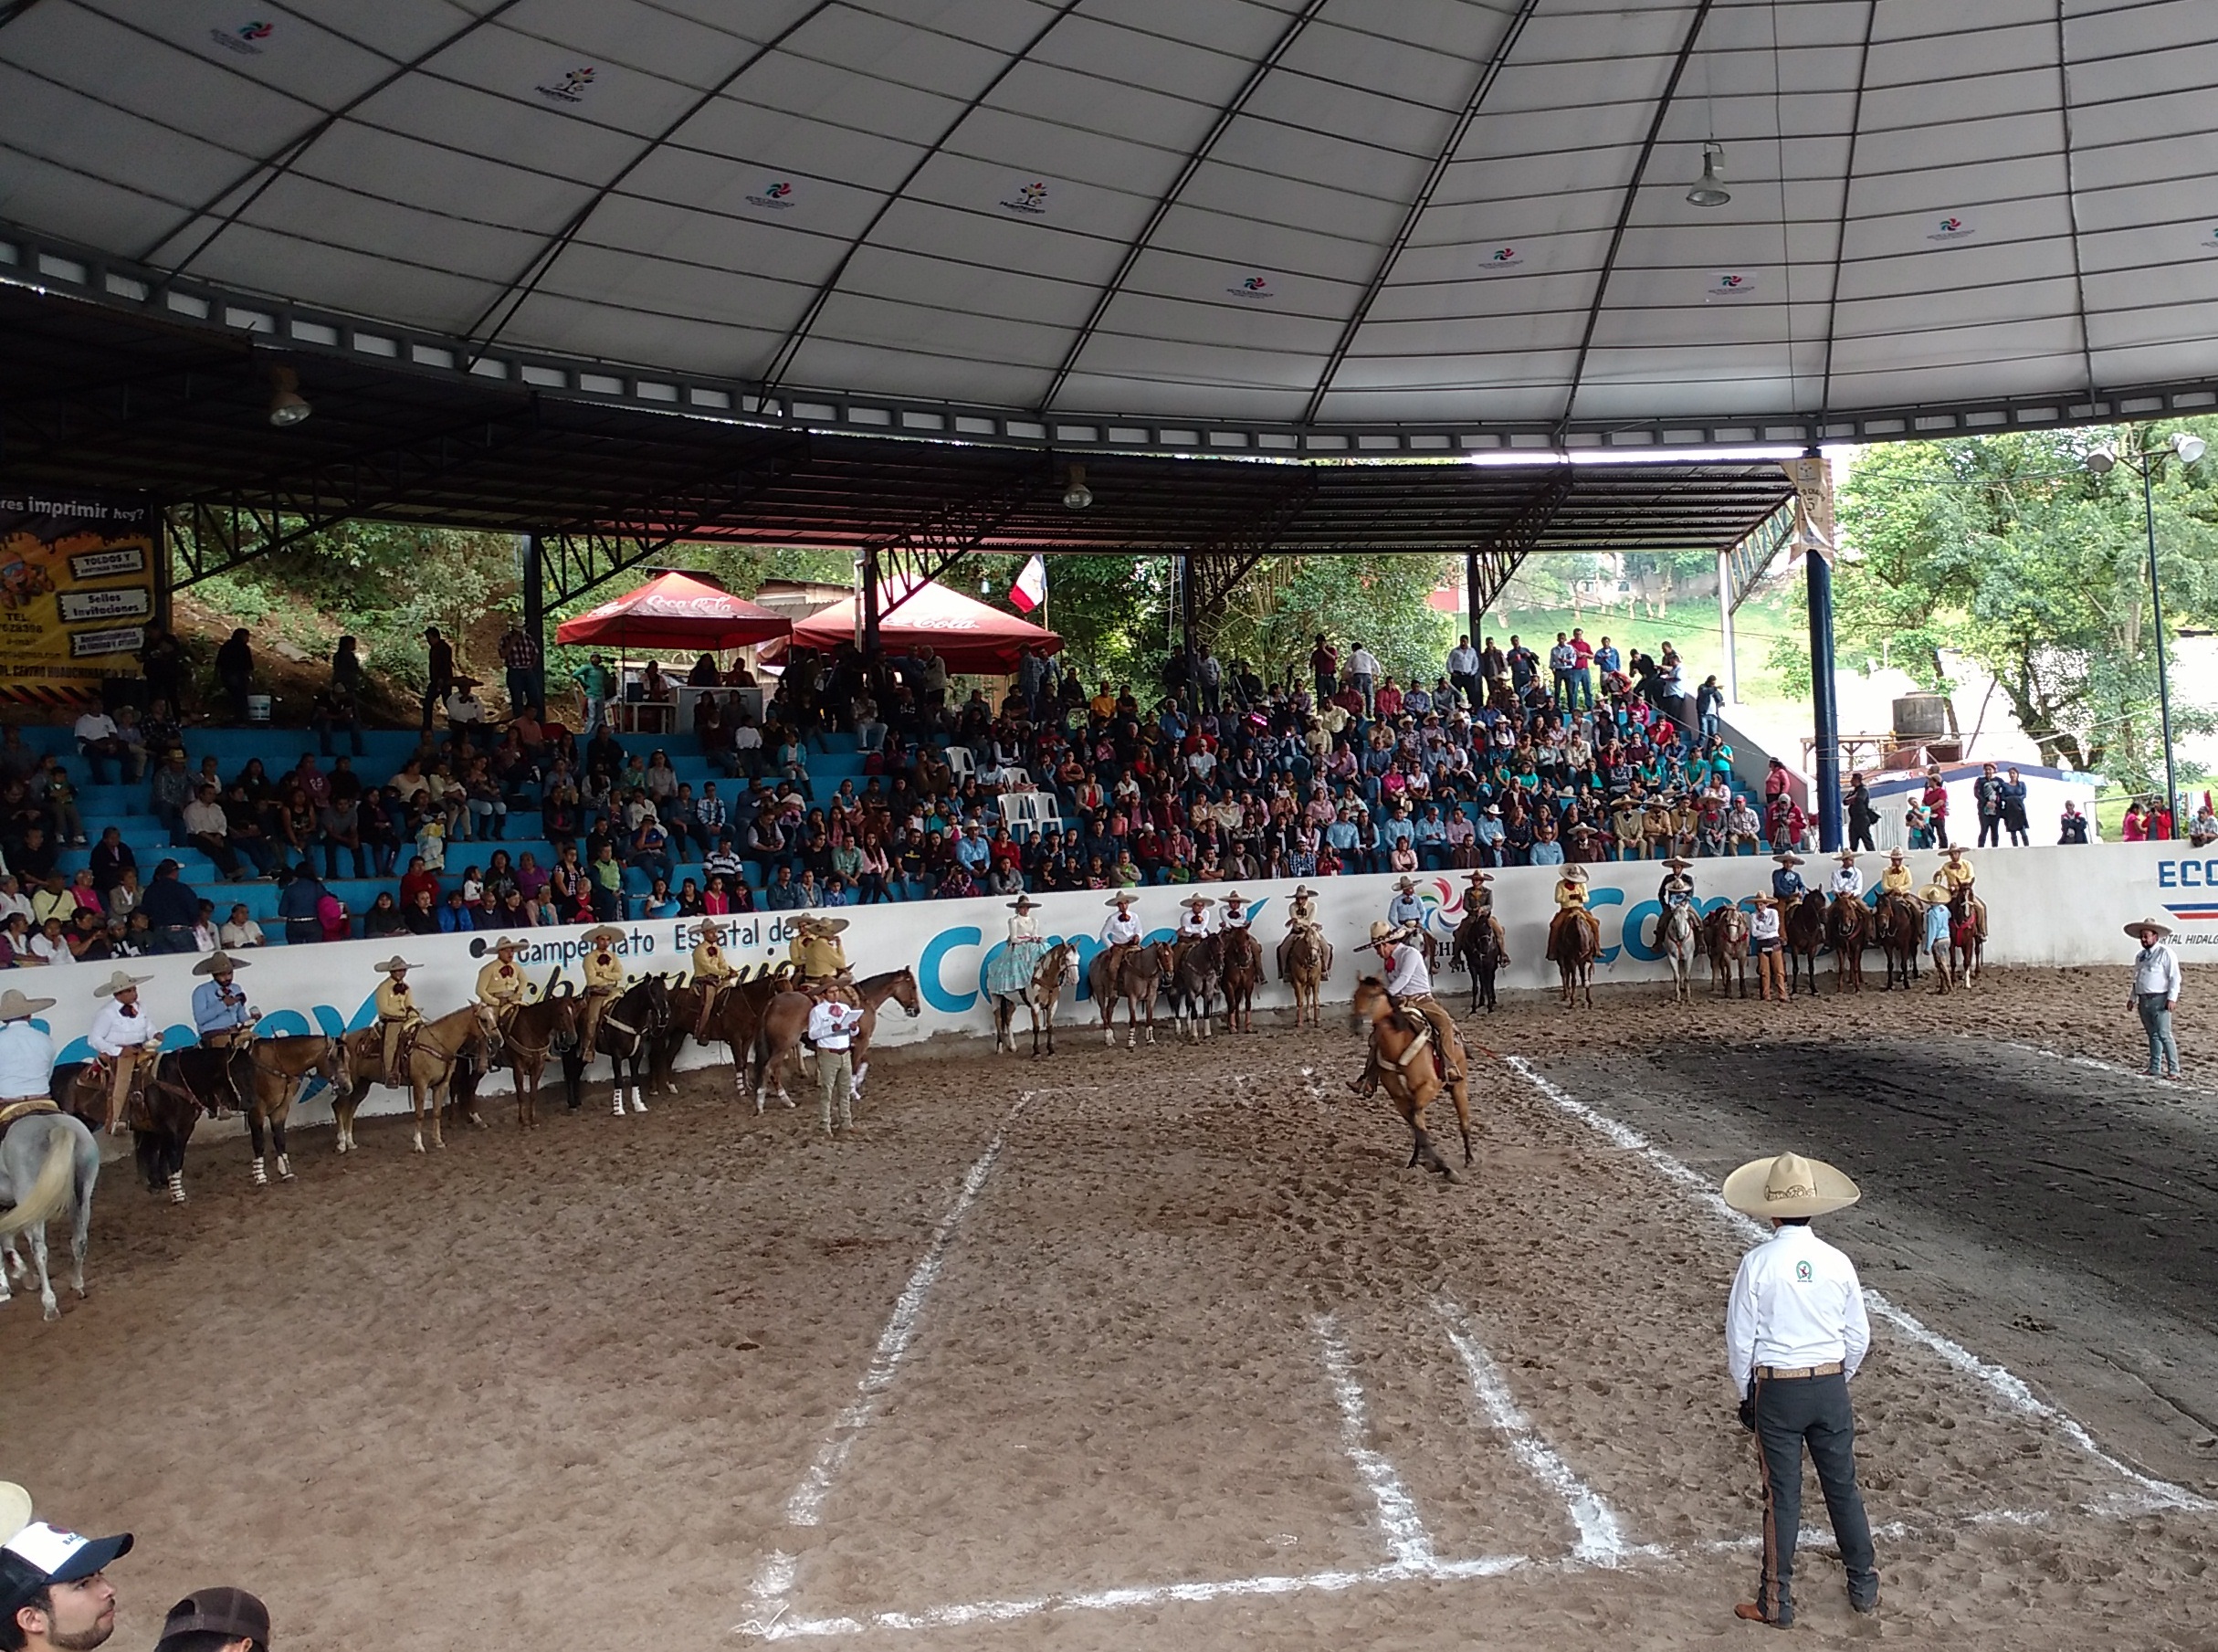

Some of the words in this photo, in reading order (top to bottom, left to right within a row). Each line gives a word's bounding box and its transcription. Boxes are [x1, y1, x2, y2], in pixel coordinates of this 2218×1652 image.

[27, 496, 108, 519] imprimir
[112, 508, 144, 521] hoy?
[84, 554, 121, 565] TOLDOS
[89, 594, 121, 603] Sellos
[73, 605, 139, 616] Invitaciones
[519, 927, 655, 967] Campeato
[675, 918, 759, 951] Esatal
[769, 916, 794, 942] de
